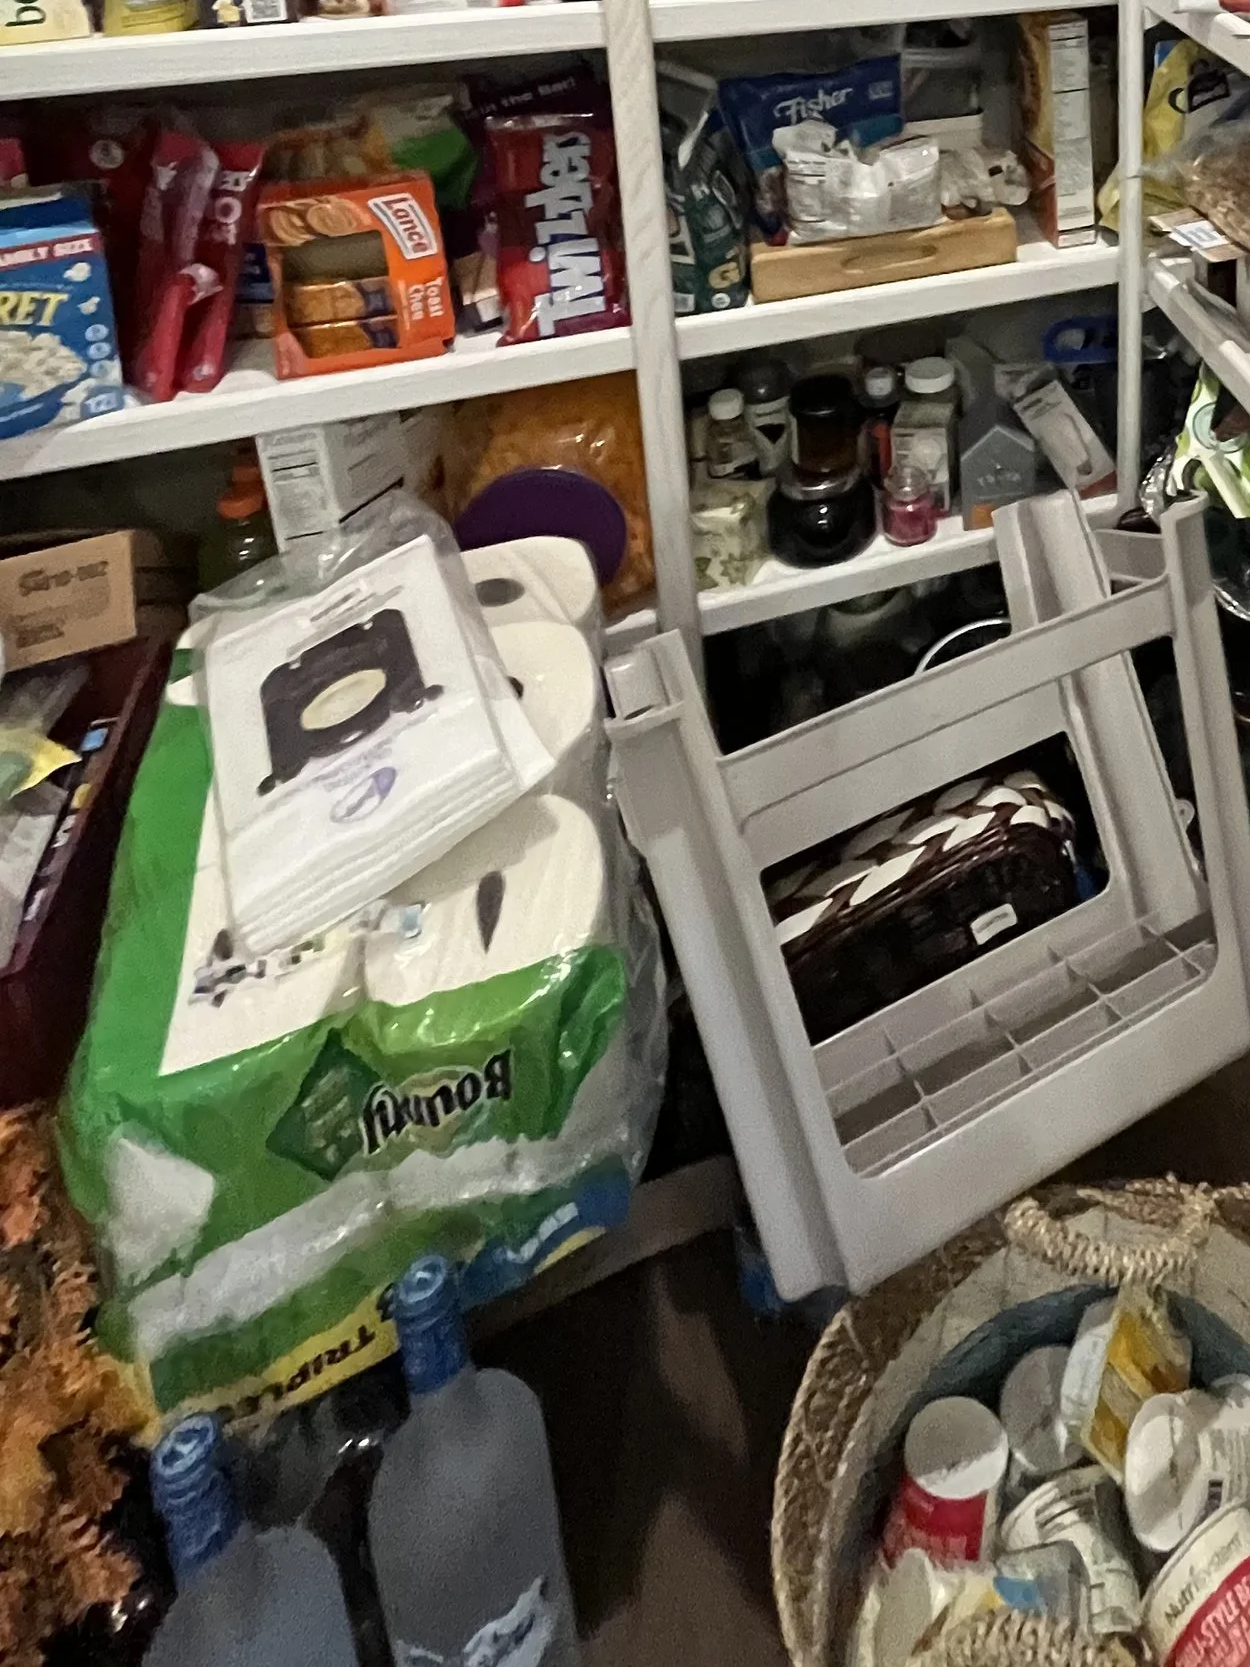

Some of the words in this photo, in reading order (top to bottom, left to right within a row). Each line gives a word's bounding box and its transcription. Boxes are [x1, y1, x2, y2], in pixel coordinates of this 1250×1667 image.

[772, 87, 853, 124] Fisher
[382, 196, 428, 254] Lance
[361, 1048, 514, 1155] Bounty
